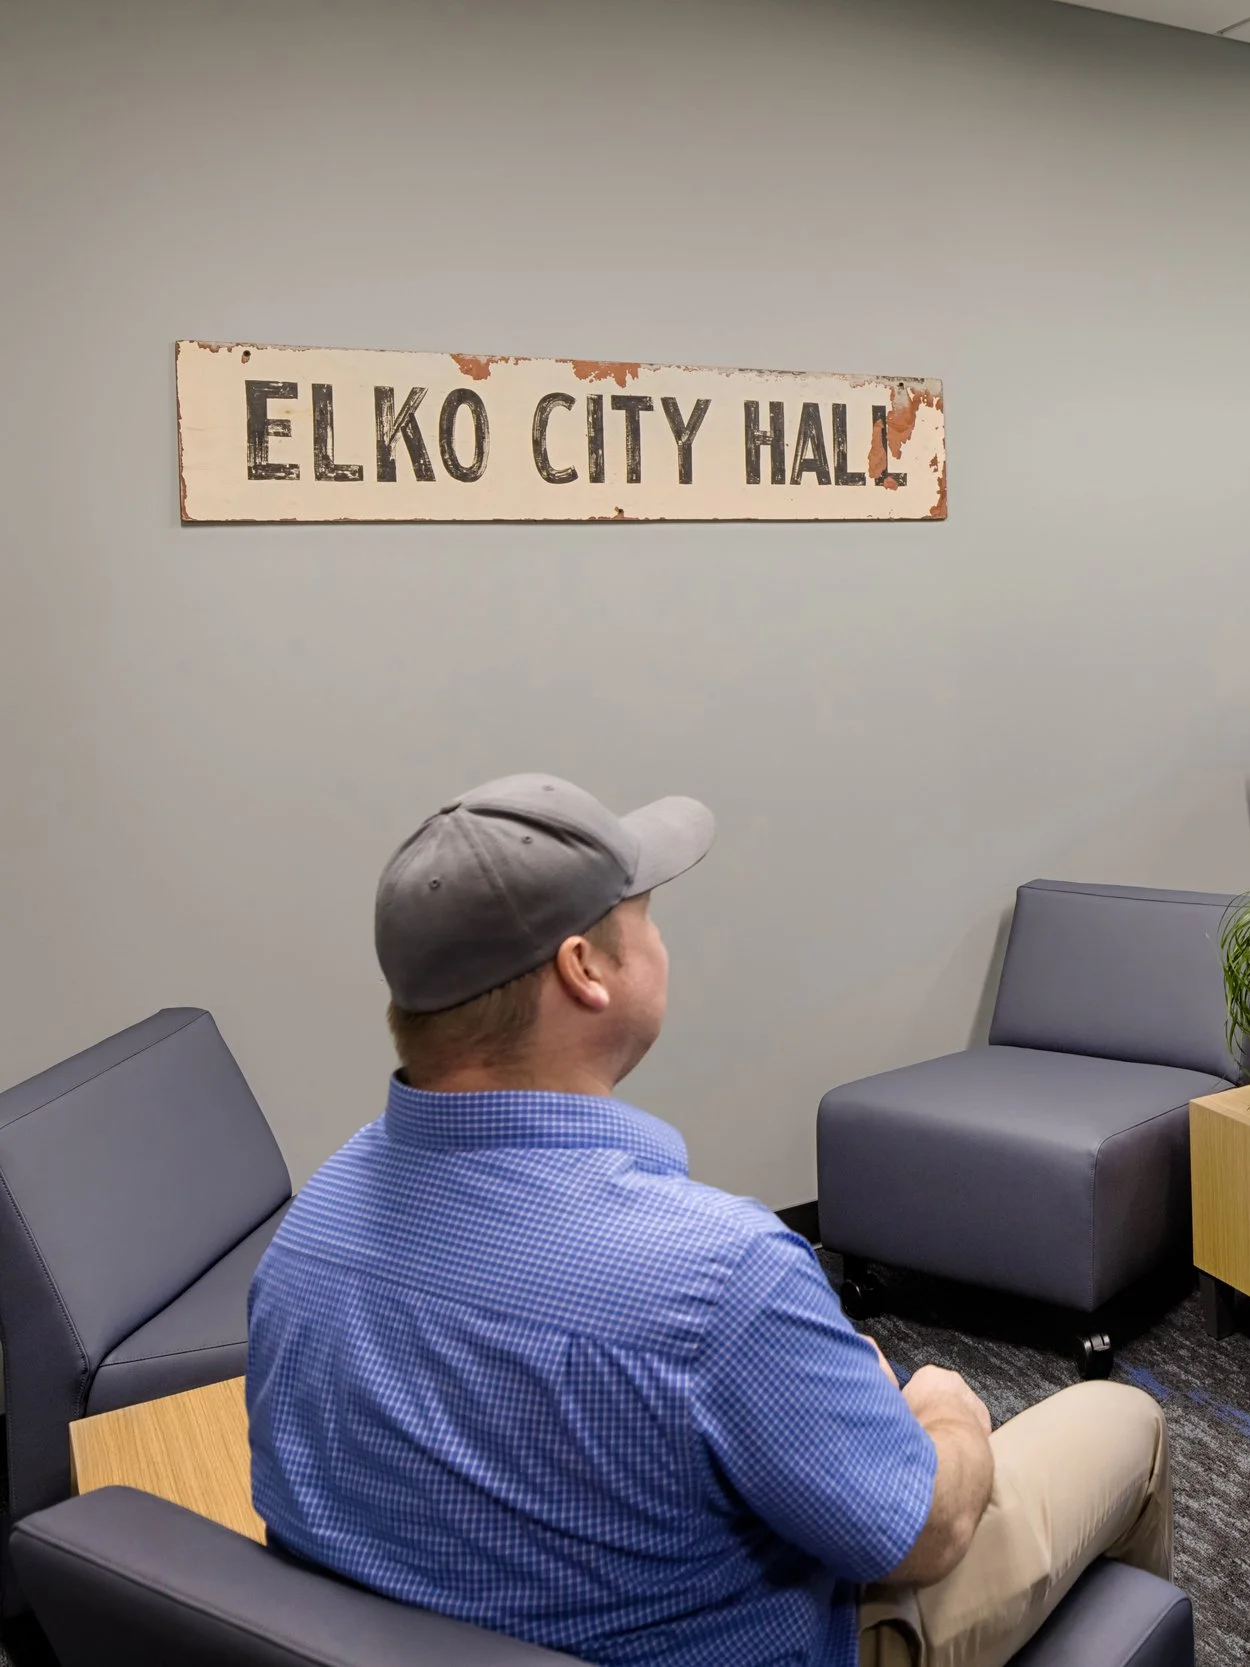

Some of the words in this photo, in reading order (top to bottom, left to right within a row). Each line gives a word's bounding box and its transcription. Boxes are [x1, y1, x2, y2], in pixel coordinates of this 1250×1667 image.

[244, 379, 490, 483] ELKO
[531, 391, 711, 485] CITY
[742, 399, 907, 487] HALL
